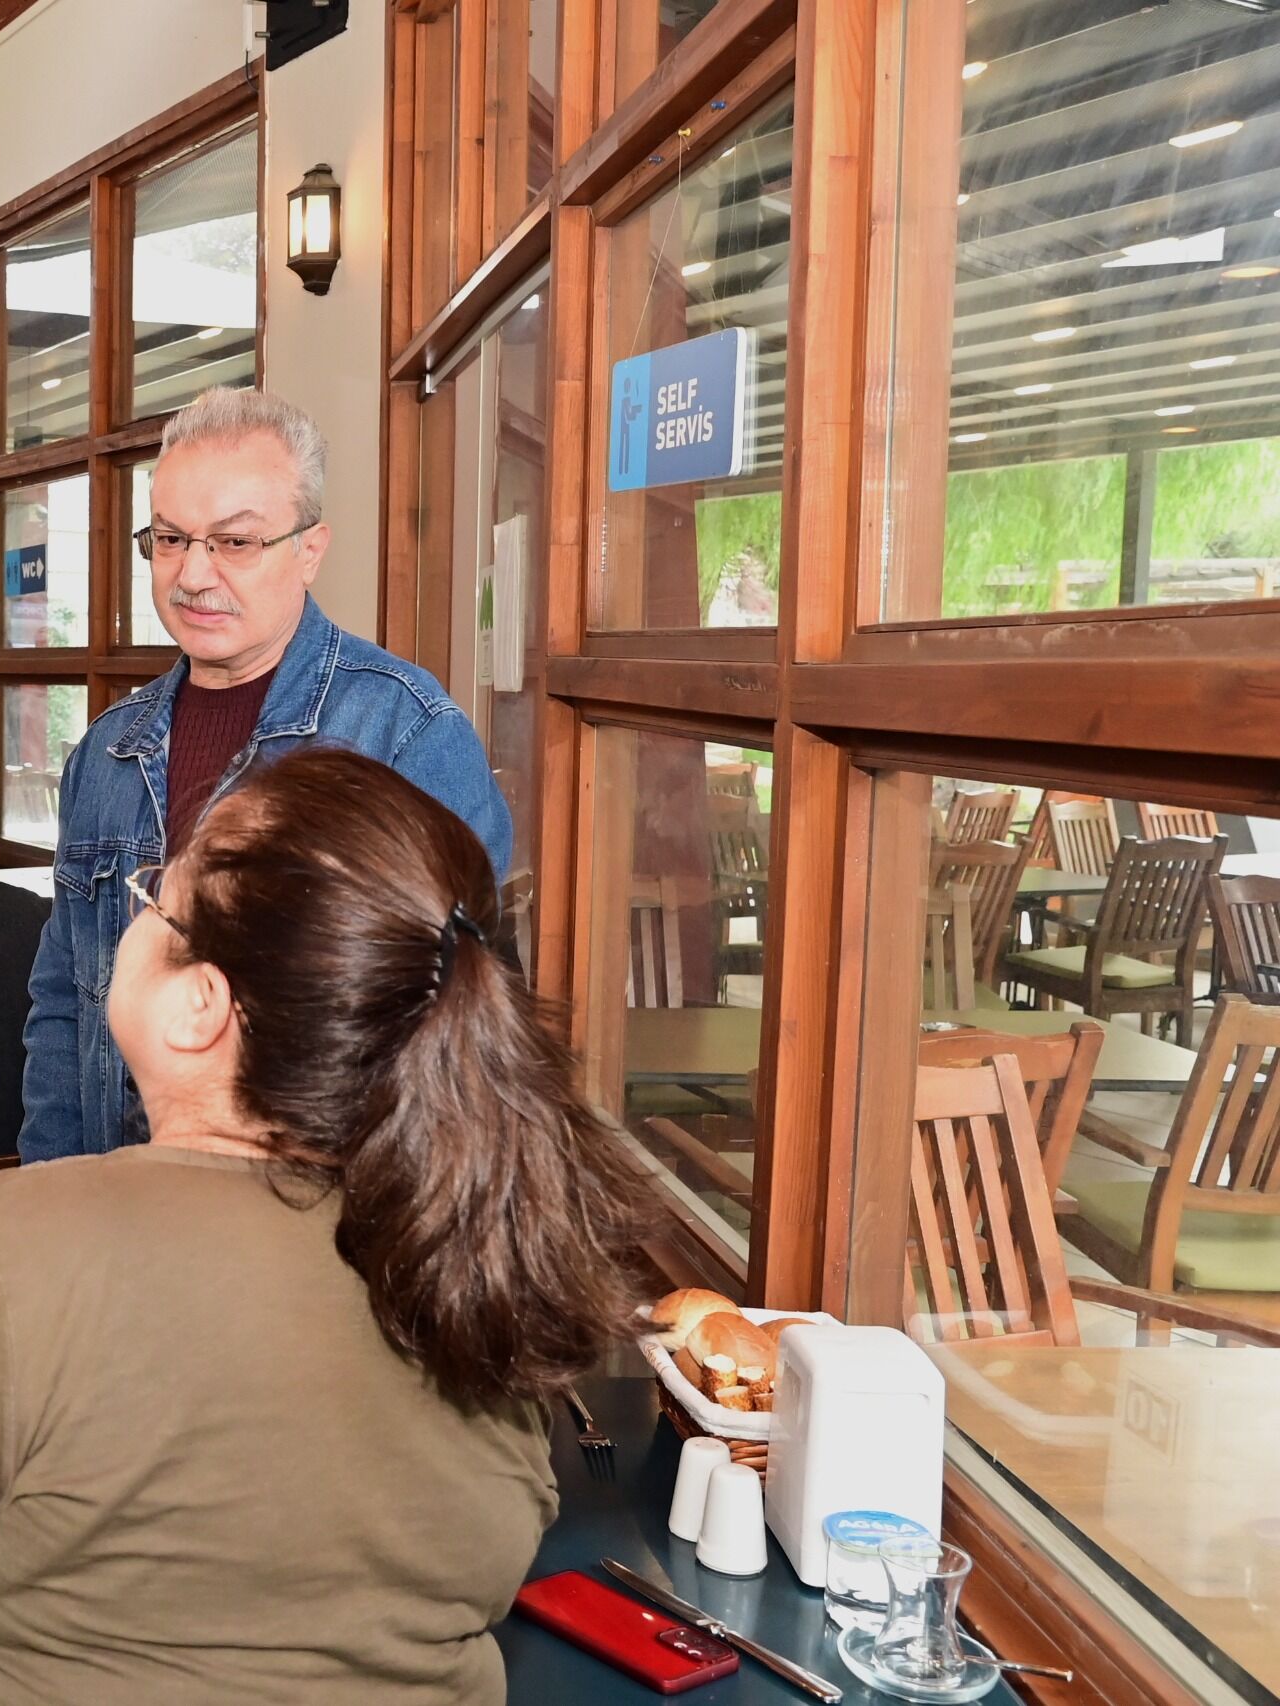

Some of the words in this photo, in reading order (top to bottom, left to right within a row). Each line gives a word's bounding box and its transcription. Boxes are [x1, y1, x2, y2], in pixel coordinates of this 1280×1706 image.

[656, 377, 698, 415] SELF
[655, 405, 714, 451] SERVİS
[21, 560, 36, 579] WC
